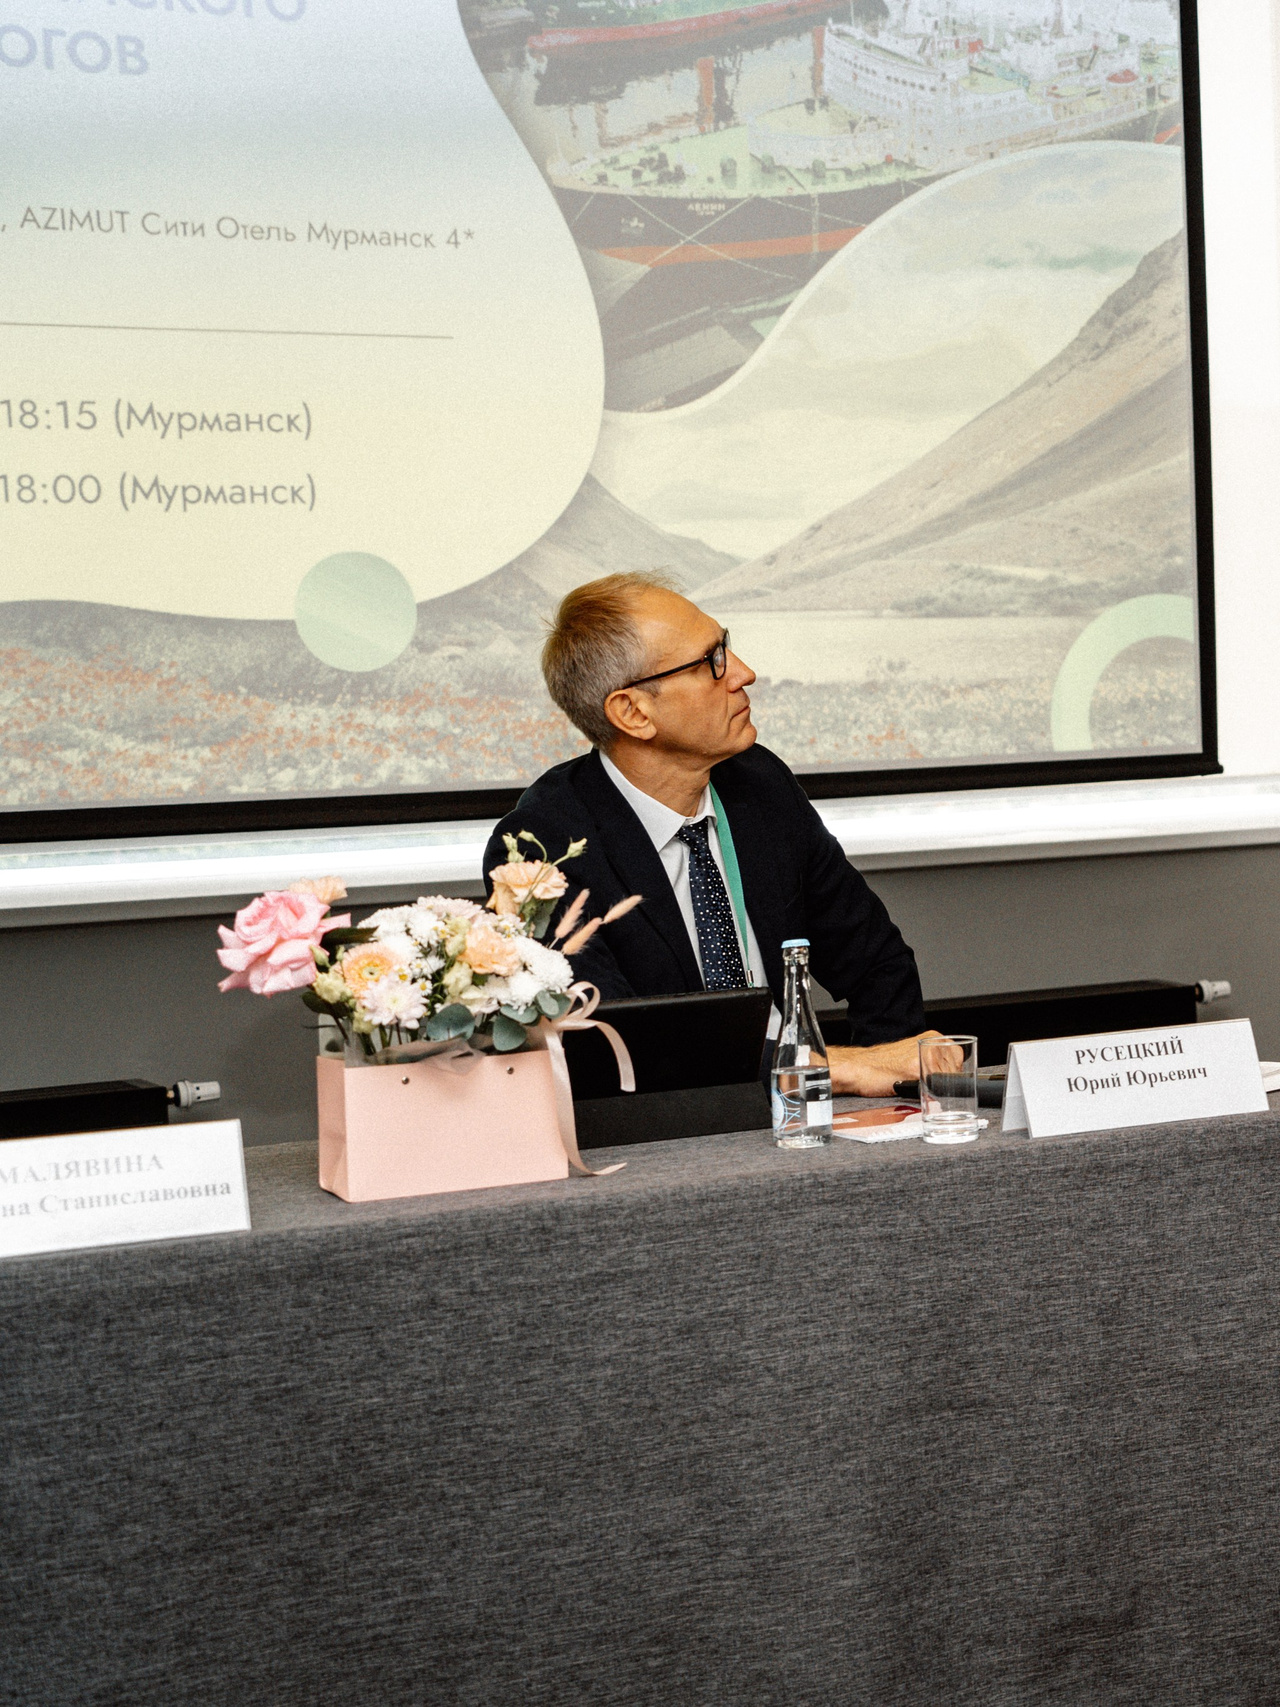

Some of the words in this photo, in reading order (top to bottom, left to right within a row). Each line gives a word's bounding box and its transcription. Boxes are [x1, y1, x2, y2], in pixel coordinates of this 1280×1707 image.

[20, 206, 130, 234] AZIMUT
[141, 212, 206, 239] Сити
[216, 216, 297, 243] Отель
[307, 221, 436, 250] Мурманск
[0, 399, 98, 430] 18:15
[114, 398, 313, 441] (Мурманск)
[0, 474, 102, 504] 18:00
[119, 471, 317, 512] (Мурманск)
[1075, 1036, 1184, 1065] РУСЕЦКИЙ
[1066, 1073, 1121, 1095] Юрий
[1126, 1066, 1208, 1088] Юрьевич
[0, 1154, 164, 1185] МАЛЯВИНА
[39, 1182, 232, 1214] Станиславовна
